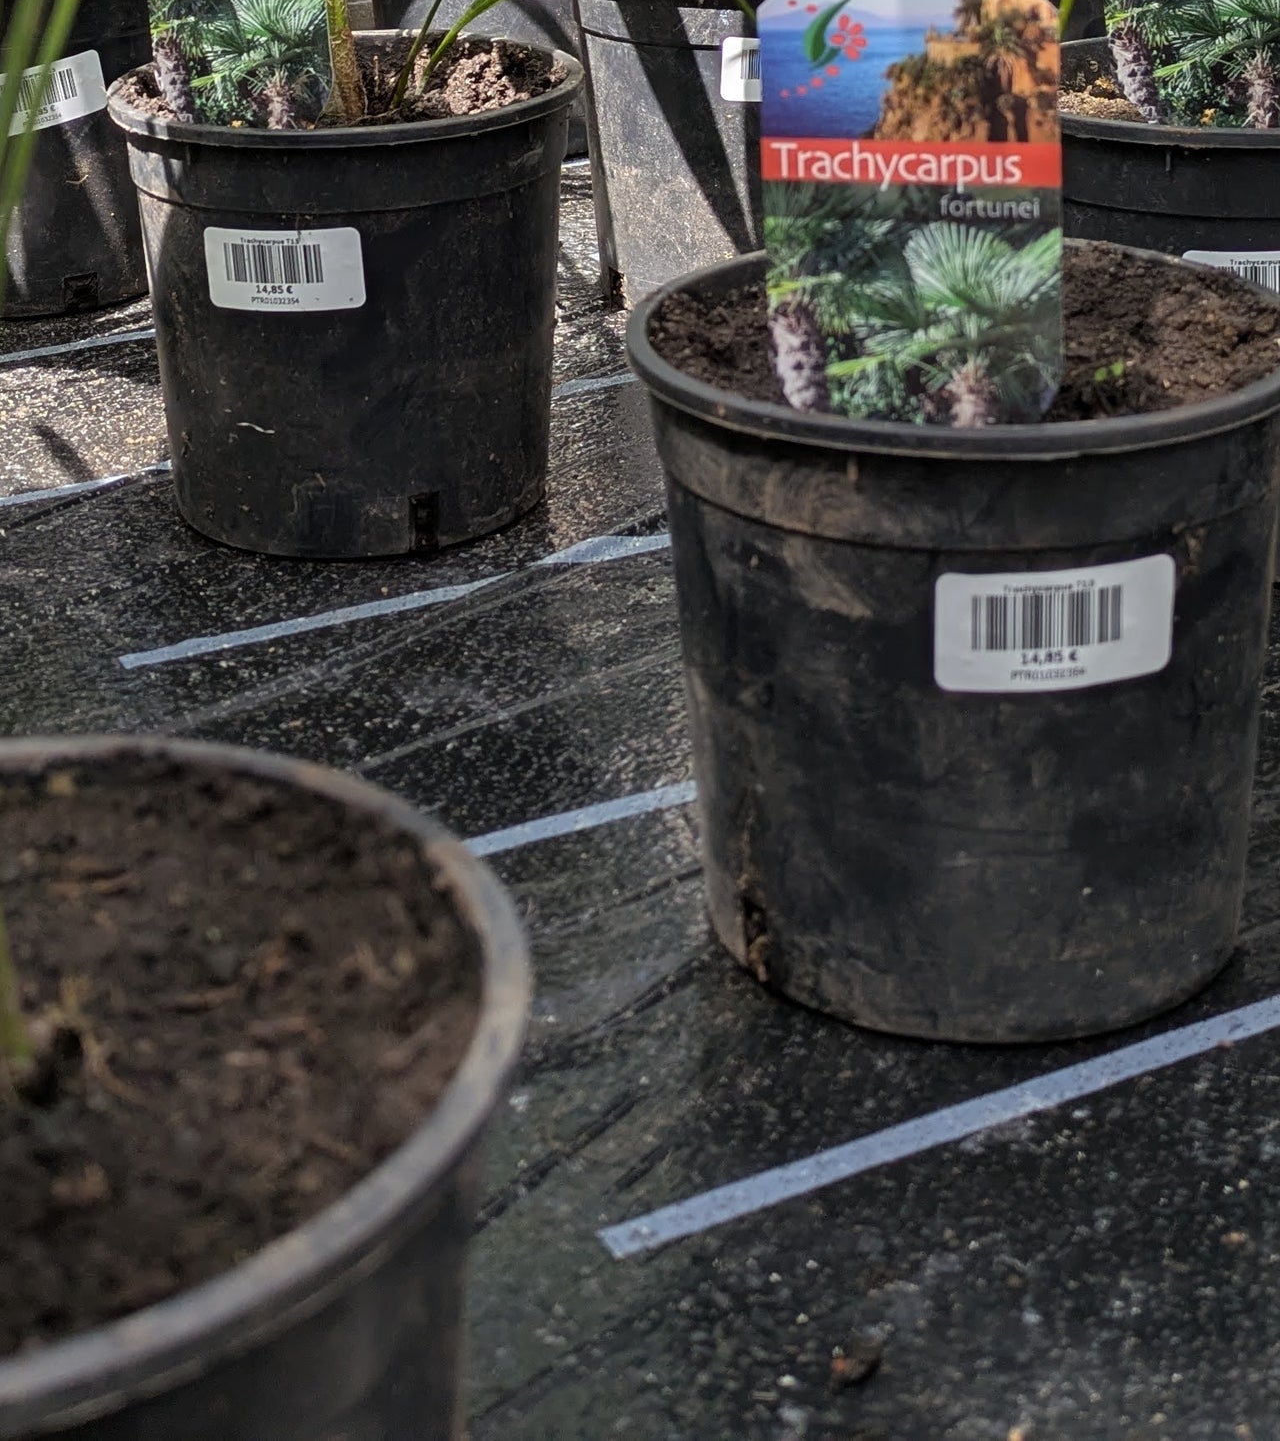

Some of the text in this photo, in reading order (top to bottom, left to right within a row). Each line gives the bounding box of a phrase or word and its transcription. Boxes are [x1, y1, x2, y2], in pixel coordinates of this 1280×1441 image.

[770, 141, 1022, 194] Trachycarpus
[939, 194, 1040, 219] fortunei
[240, 237, 284, 245] Trachycarpus
[255, 285, 293, 295] 14,85 €
